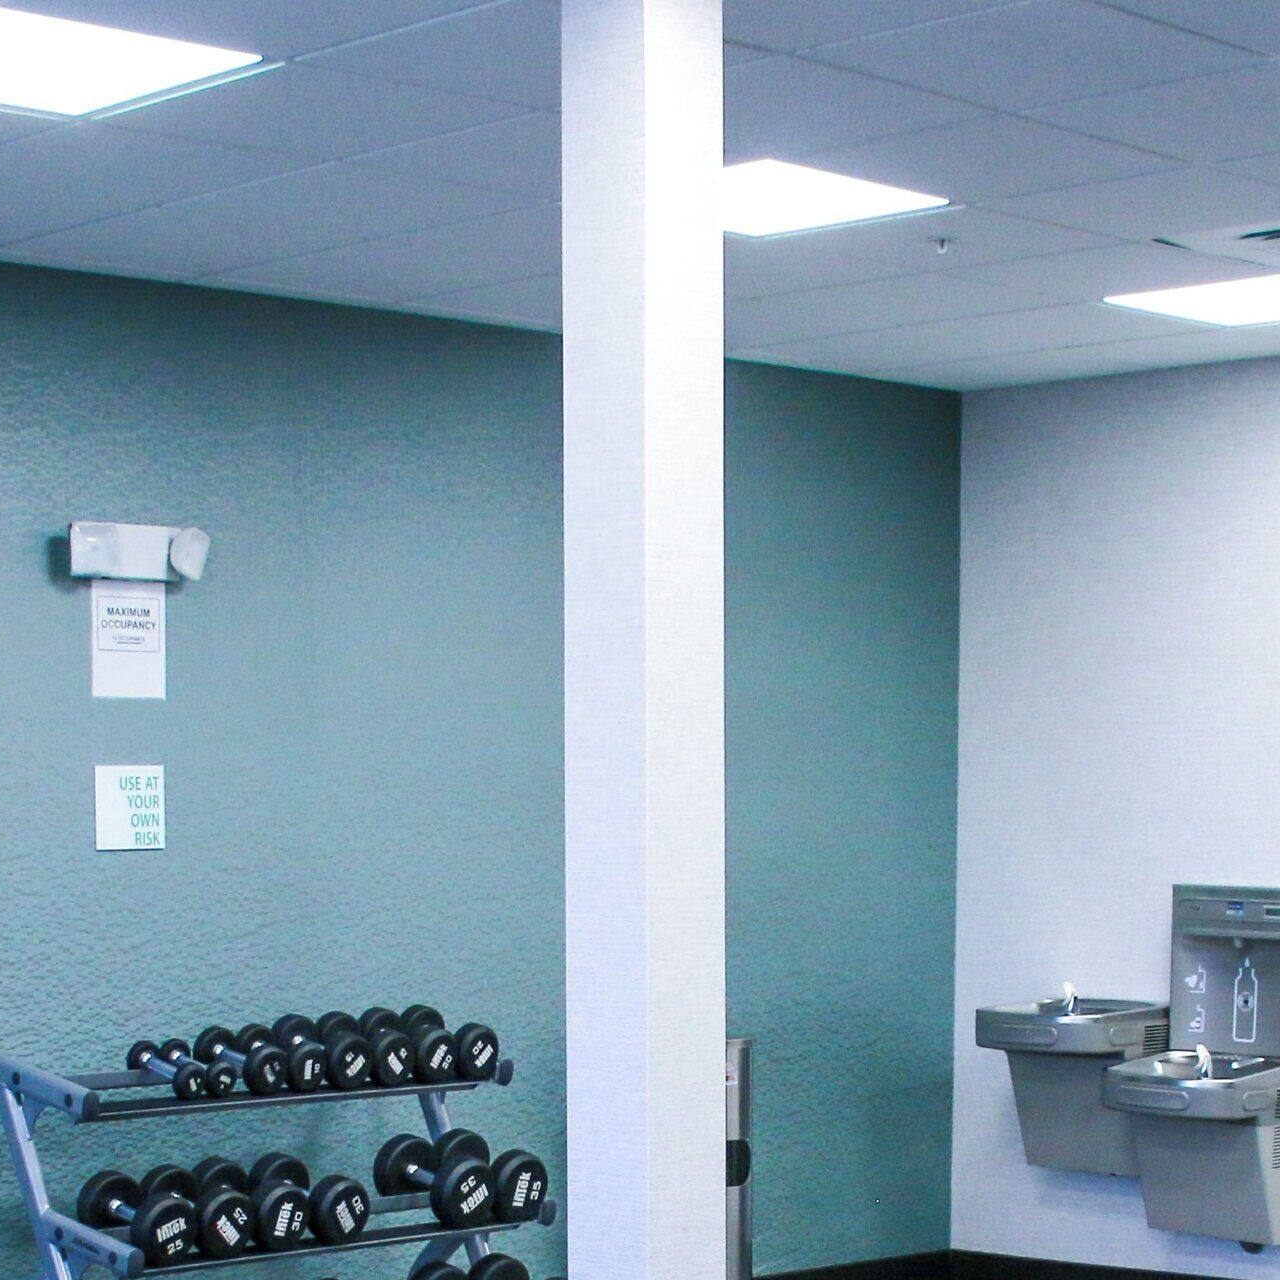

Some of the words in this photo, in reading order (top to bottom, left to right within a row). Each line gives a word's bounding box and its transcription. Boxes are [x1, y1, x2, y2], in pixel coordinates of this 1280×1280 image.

[107, 607, 151, 617] MAXIMUM
[101, 619, 157, 630] OCCUPANCY
[119, 776, 141, 791] USE
[145, 776, 159, 790] AT
[127, 794, 160, 809] YOUR
[130, 813, 160, 827] OWN
[135, 831, 161, 846] RISK
[472, 1040, 484, 1055] 20
[441, 1054, 453, 1070] 20
[460, 1175, 477, 1194] 35
[530, 1180, 541, 1200] 35
[352, 1195, 364, 1214] 30
[233, 1206, 248, 1225] 25
[291, 1211, 304, 1231] 30
[167, 1239, 184, 1255] 25
